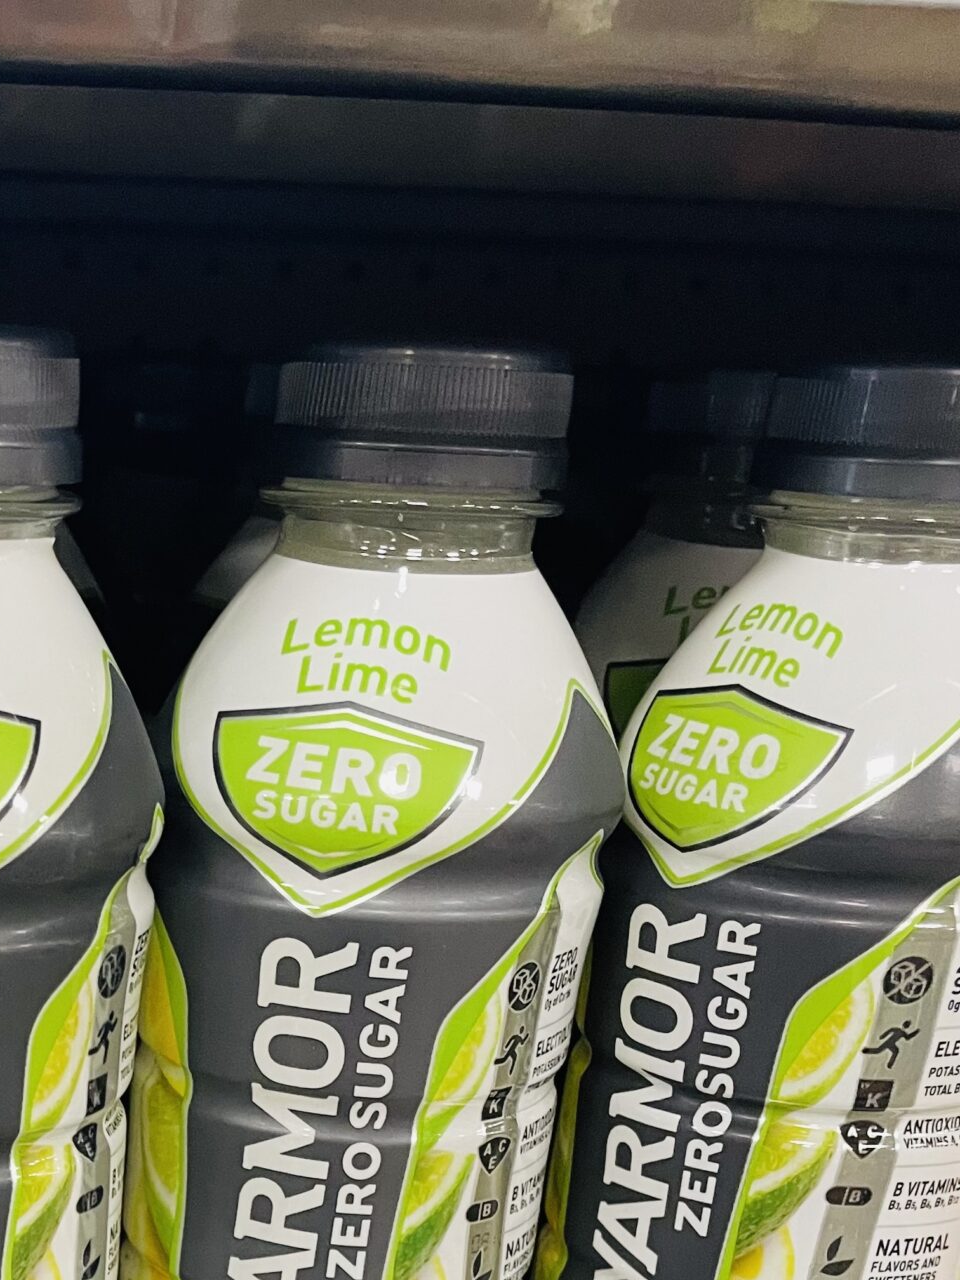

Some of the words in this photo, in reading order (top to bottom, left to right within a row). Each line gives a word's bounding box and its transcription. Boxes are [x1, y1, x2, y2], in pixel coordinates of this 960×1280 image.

[280, 617, 452, 673] Lemon
[714, 602, 844, 659] Lemon
[296, 652, 419, 705] Lime
[706, 635, 801, 688] Lime
[245, 735, 423, 801] ZERO
[645, 712, 782, 781] ZERO
[252, 790, 400, 836] SUGAR
[638, 762, 749, 814] SUGAR
[547, 963, 578, 995] SUGAR
[551, 947, 578, 974] ZERO
[694, 919, 762, 1099] SUGAR
[348, 946, 414, 1130] SUGAR
[924, 1084, 952, 1097] TOTAL
[903, 1136, 949, 1149] VITAMINS
[511, 1185, 519, 1202] B
[674, 1100, 732, 1238] ZERO
[893, 1181, 904, 1197] B
[870, 1258, 920, 1273] FLAVORS
[921, 1255, 941, 1270] AND
[875, 1233, 950, 1258] NATURAL
